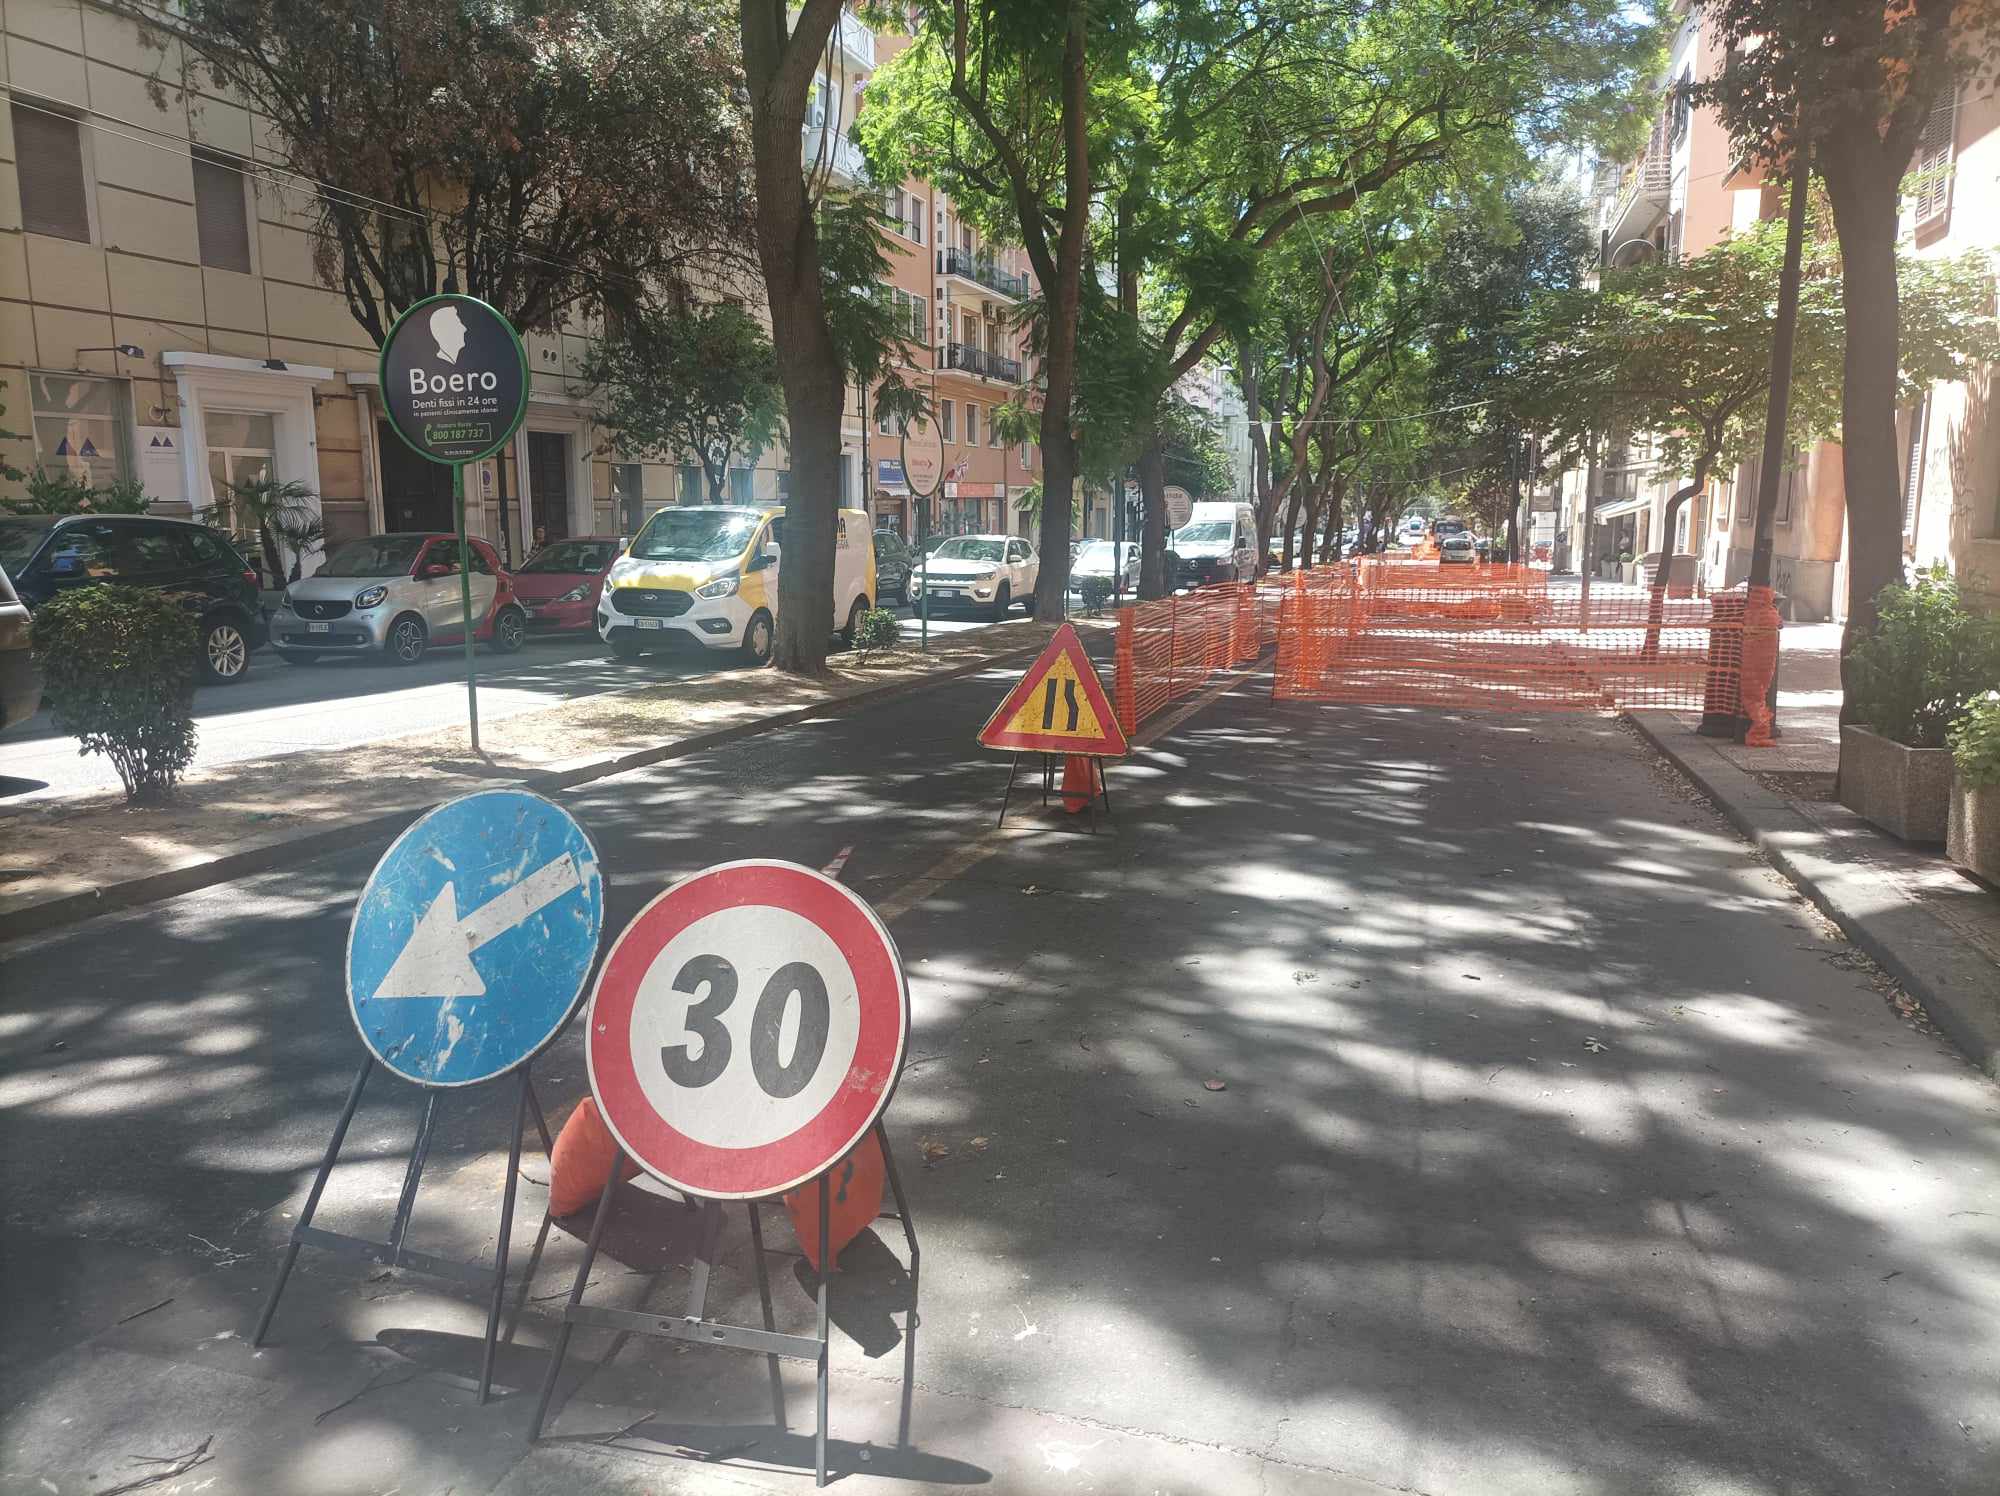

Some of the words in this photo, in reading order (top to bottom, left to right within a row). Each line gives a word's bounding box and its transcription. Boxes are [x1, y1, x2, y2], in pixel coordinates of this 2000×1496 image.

[409, 368, 497, 394] Boero
[412, 398, 437, 409] Denti
[439, 396, 455, 407] fissi
[457, 397, 465, 406] in
[467, 396, 480, 406] 24
[481, 397, 497, 405] ore
[432, 430, 449, 440] 800
[451, 429, 466, 439] 187
[468, 428, 484, 438] 737
[661, 953, 830, 1099] 30
